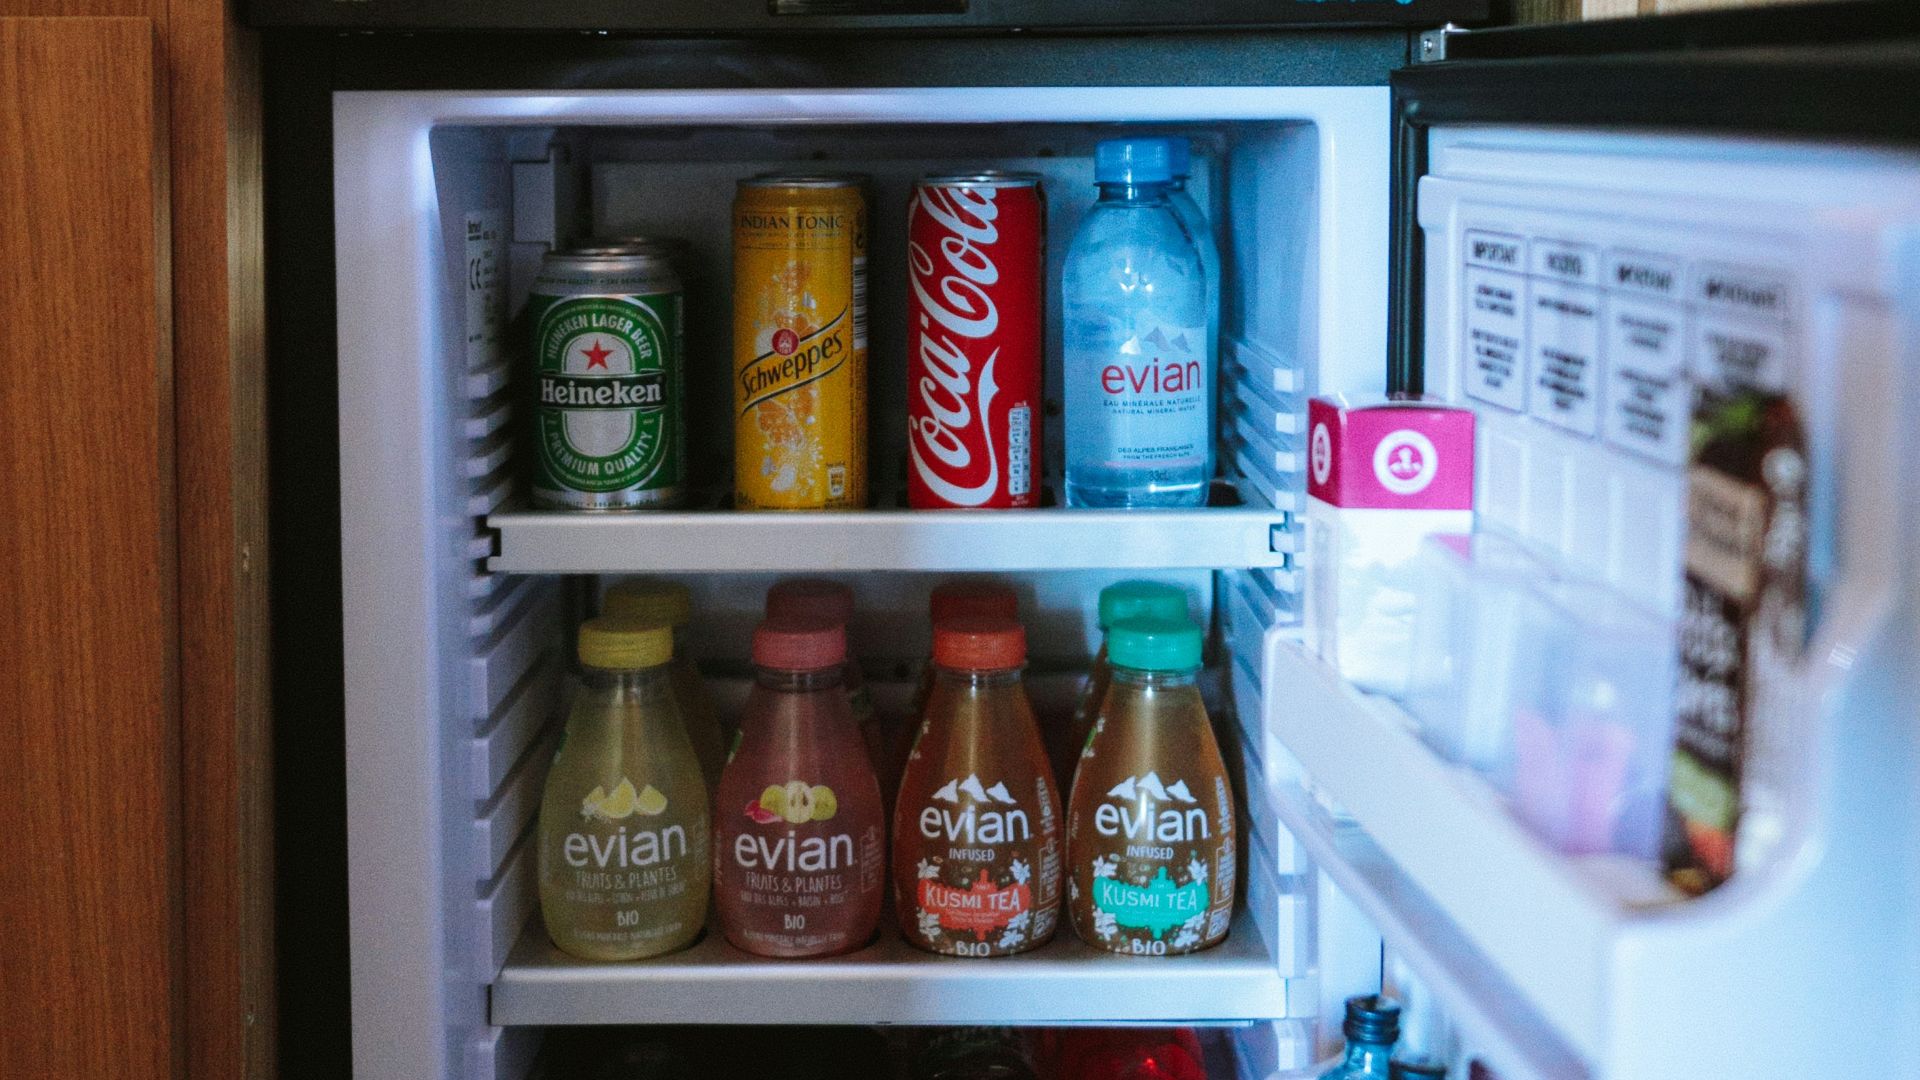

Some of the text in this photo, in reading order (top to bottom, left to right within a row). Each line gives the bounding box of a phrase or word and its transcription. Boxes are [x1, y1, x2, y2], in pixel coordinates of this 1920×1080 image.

[740, 214, 846, 230] INDIAN TONIC
[546, 312, 652, 360] HEINEKEN LAGER BEER
[907, 187, 1000, 507] Coca-Cola
[741, 329, 844, 402] Schweppes
[1101, 356, 1202, 394] evian
[541, 377, 663, 406] Heineken
[1103, 399, 1119, 408] EAU
[1147, 407, 1176, 415] MINERAL
[549, 430, 653, 477] PREMIUM QUALITY
[920, 804, 1030, 844] evian
[1094, 803, 1209, 843] evian
[564, 824, 687, 868] evian
[734, 830, 854, 872] evian
[949, 848, 996, 862] INFUSED
[1126, 845, 1175, 861] INFUSED
[575, 865, 678, 890] FRUITS & PLANTES
[745, 871, 843, 894] FRUITS & PLANTES
[925, 883, 1021, 911] KUSMI TEA
[1103, 883, 1198, 911] KUSMI TEA
[616, 909, 640, 927] BIO
[783, 913, 805, 930] BIO
[956, 940, 991, 957] BIO
[1131, 938, 1166, 956] BIO
